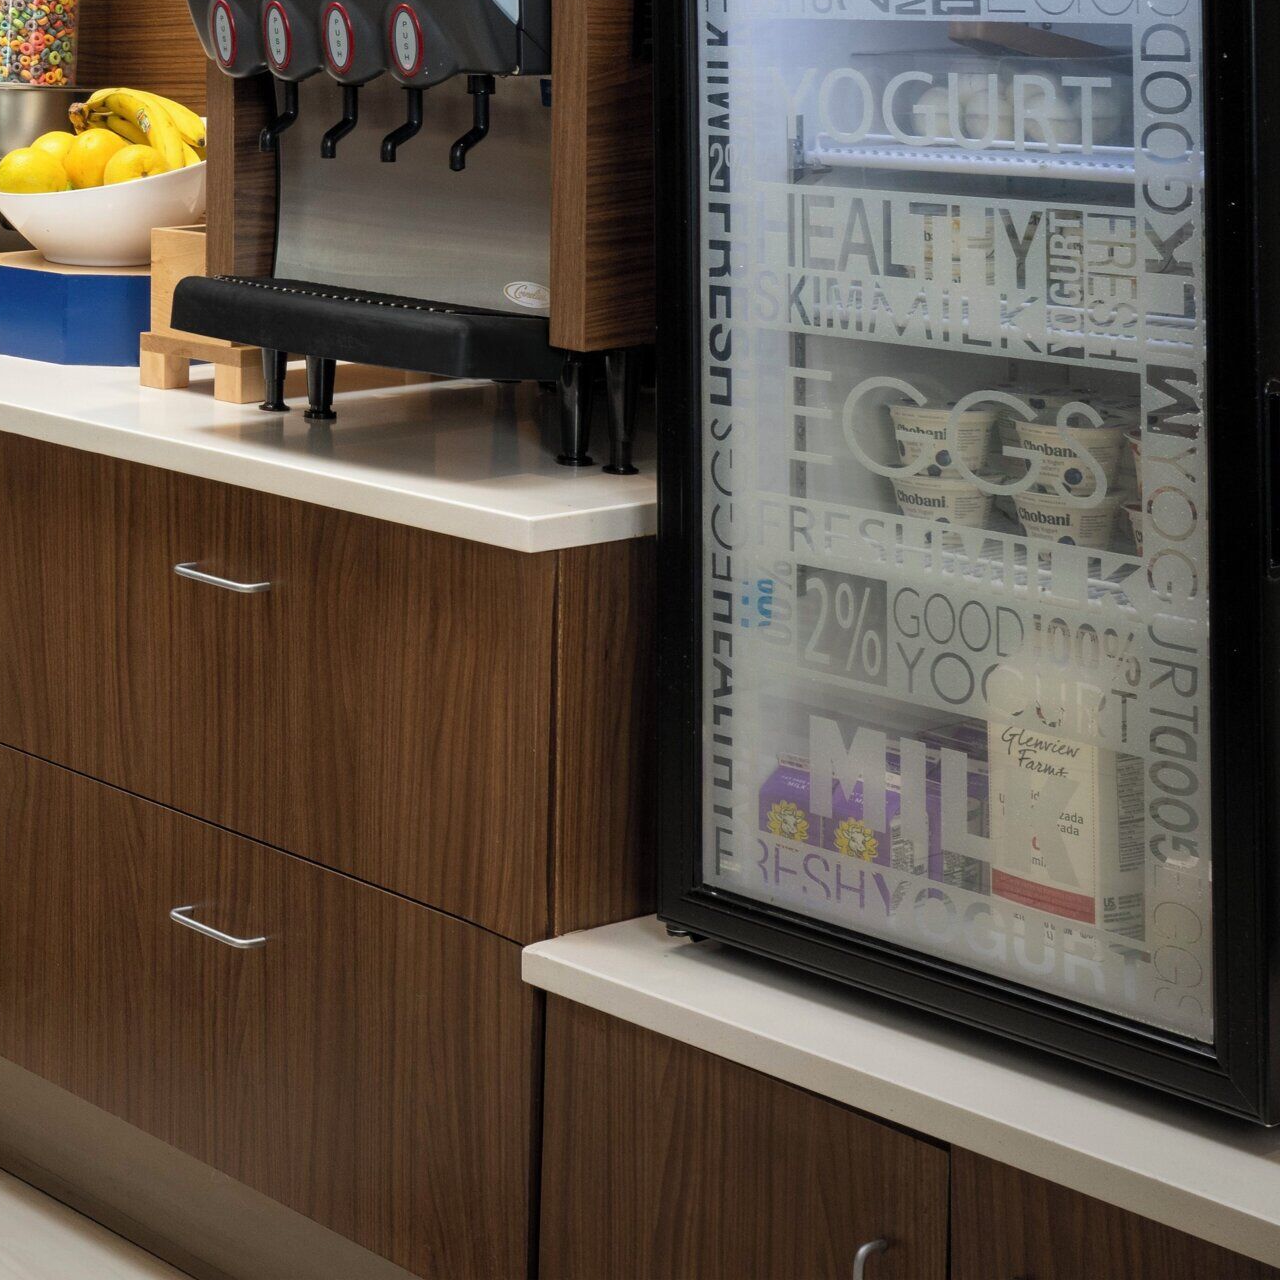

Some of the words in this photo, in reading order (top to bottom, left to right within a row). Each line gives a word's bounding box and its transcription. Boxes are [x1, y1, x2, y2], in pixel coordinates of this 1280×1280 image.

[765, 66, 1112, 156] YOGURT
[1141, 22, 1194, 216] GOOD
[897, 489, 947, 508] Chobani
[1018, 506, 1072, 527] Chobani
[893, 586, 1025, 658] GOOD
[1001, 716, 1080, 758] Glenview
